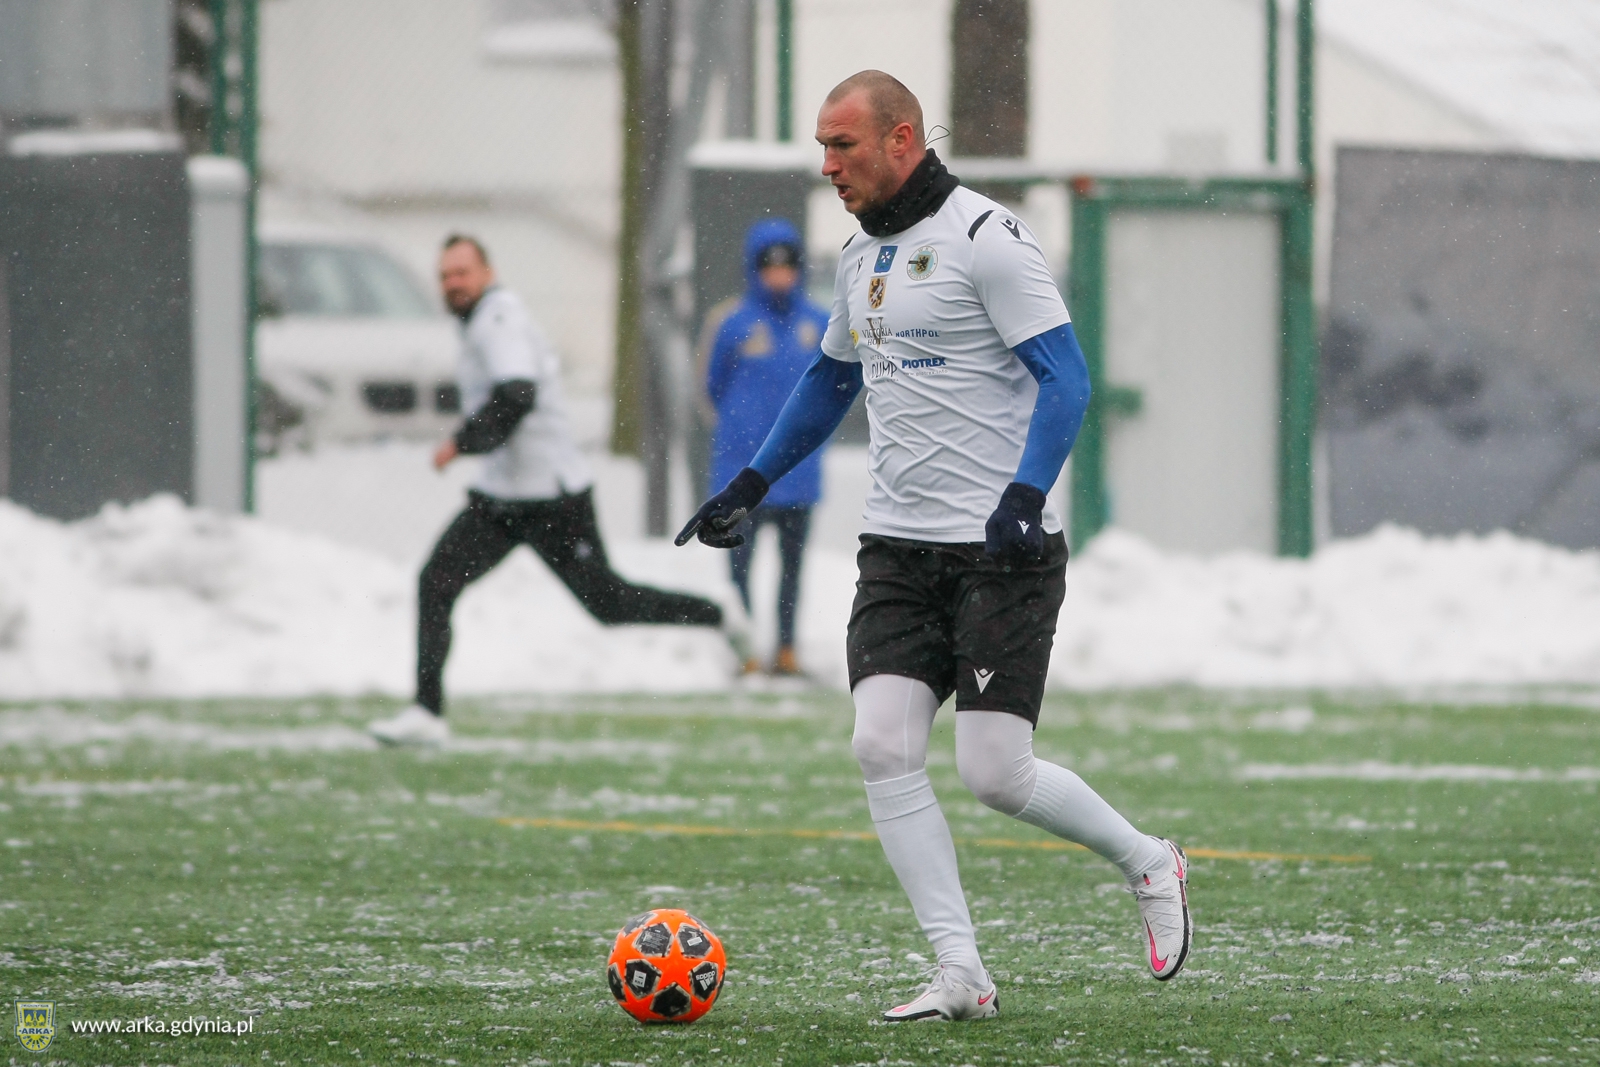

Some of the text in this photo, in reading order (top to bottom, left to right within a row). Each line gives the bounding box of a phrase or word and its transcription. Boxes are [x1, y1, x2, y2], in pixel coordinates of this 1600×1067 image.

[862, 327, 893, 338] VICTORIA
[895, 328, 940, 337] NORTHPOL
[901, 357, 946, 369] PIOTREX
